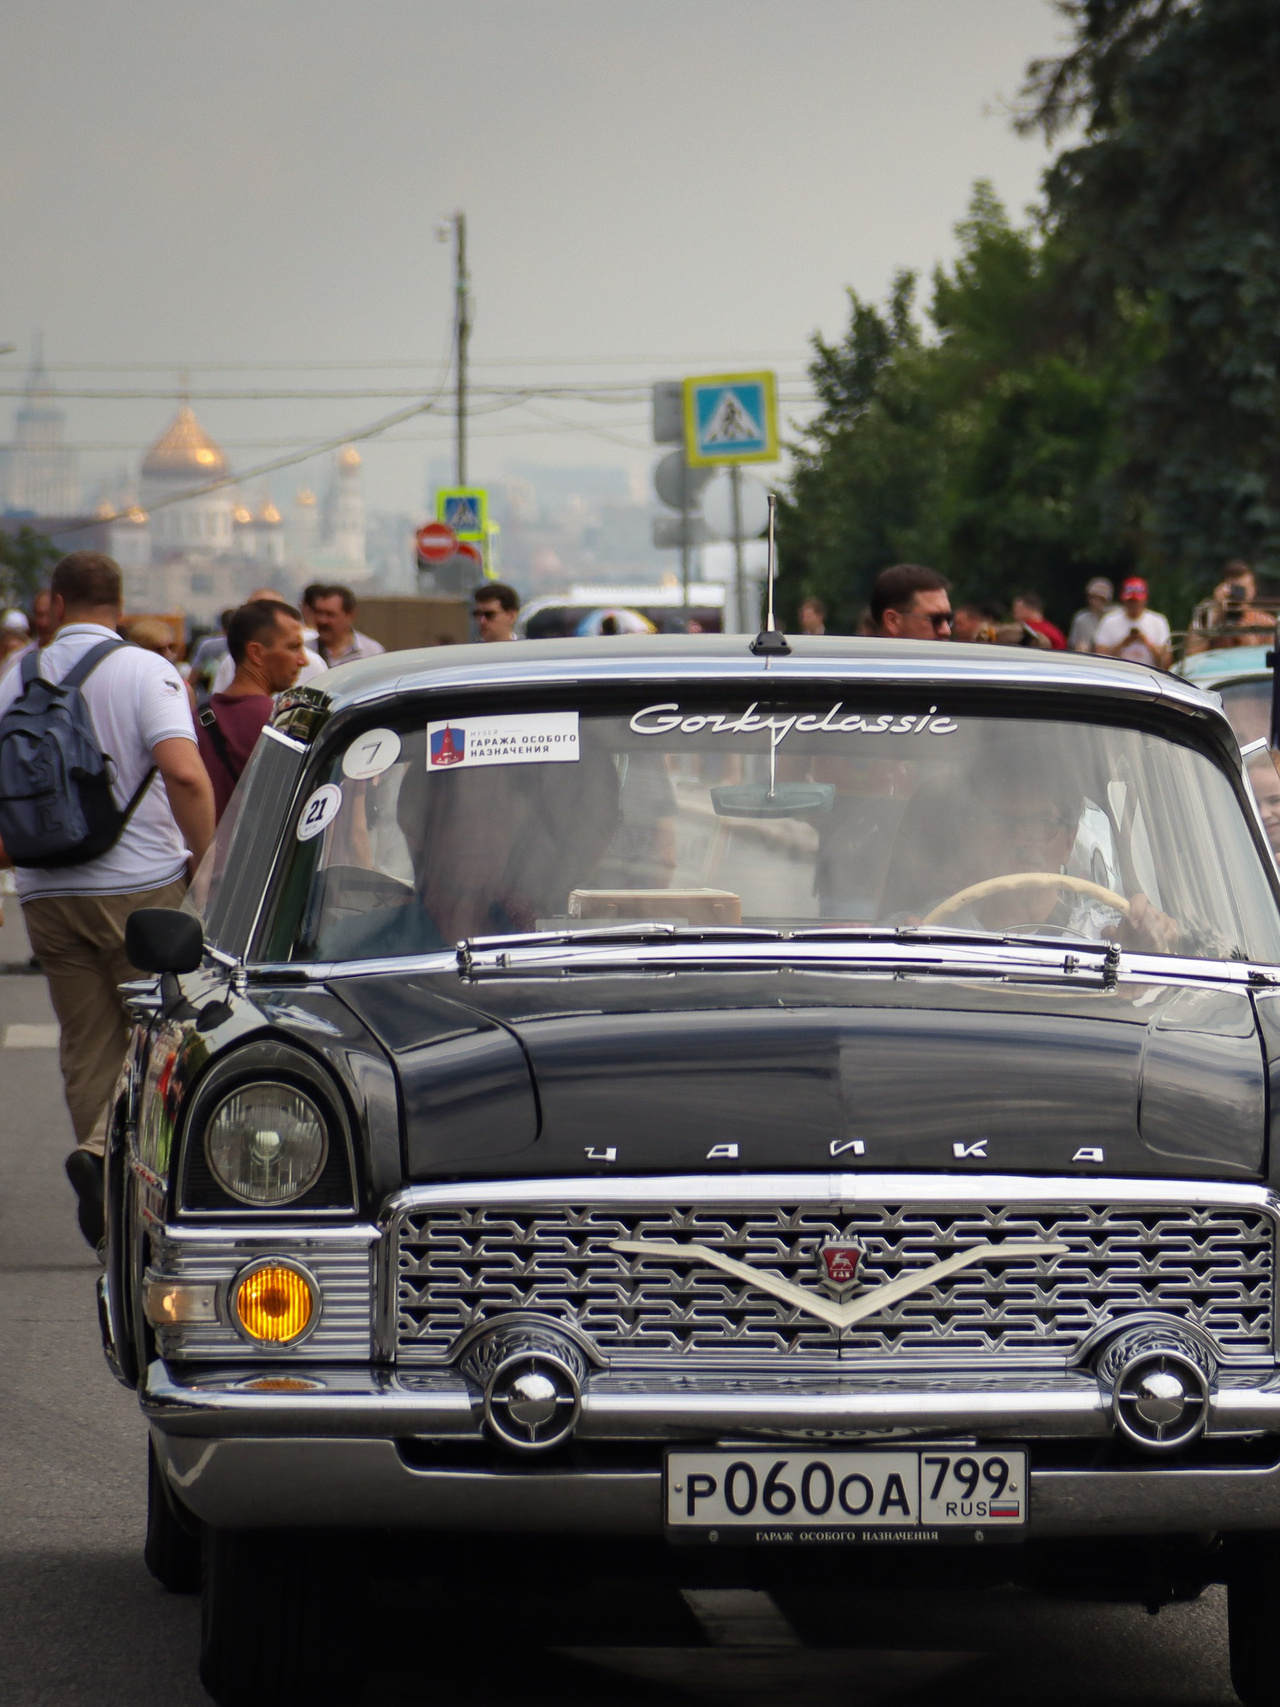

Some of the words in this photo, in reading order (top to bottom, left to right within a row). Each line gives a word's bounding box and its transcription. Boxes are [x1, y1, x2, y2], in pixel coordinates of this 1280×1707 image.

[629, 701, 958, 746] Gorkyclassic
[470, 728, 499, 737] МУЗЕЙ
[470, 737, 517, 748] ГАРАЖА
[521, 733, 577, 745] ОСОБОГО
[361, 740, 383, 765] 7
[470, 744, 550, 758] НАЗНАЧЕНИЯ
[305, 796, 329, 826] 21
[686, 1460, 911, 1516] Р060ОА
[924, 1456, 1010, 1500] 799
[945, 1501, 987, 1516] RUS
[755, 1531, 794, 1541] ГАРАЖ
[799, 1531, 856, 1541] ОСОБОГО
[862, 1531, 939, 1541] НАЗНАЧЕНИЯ
